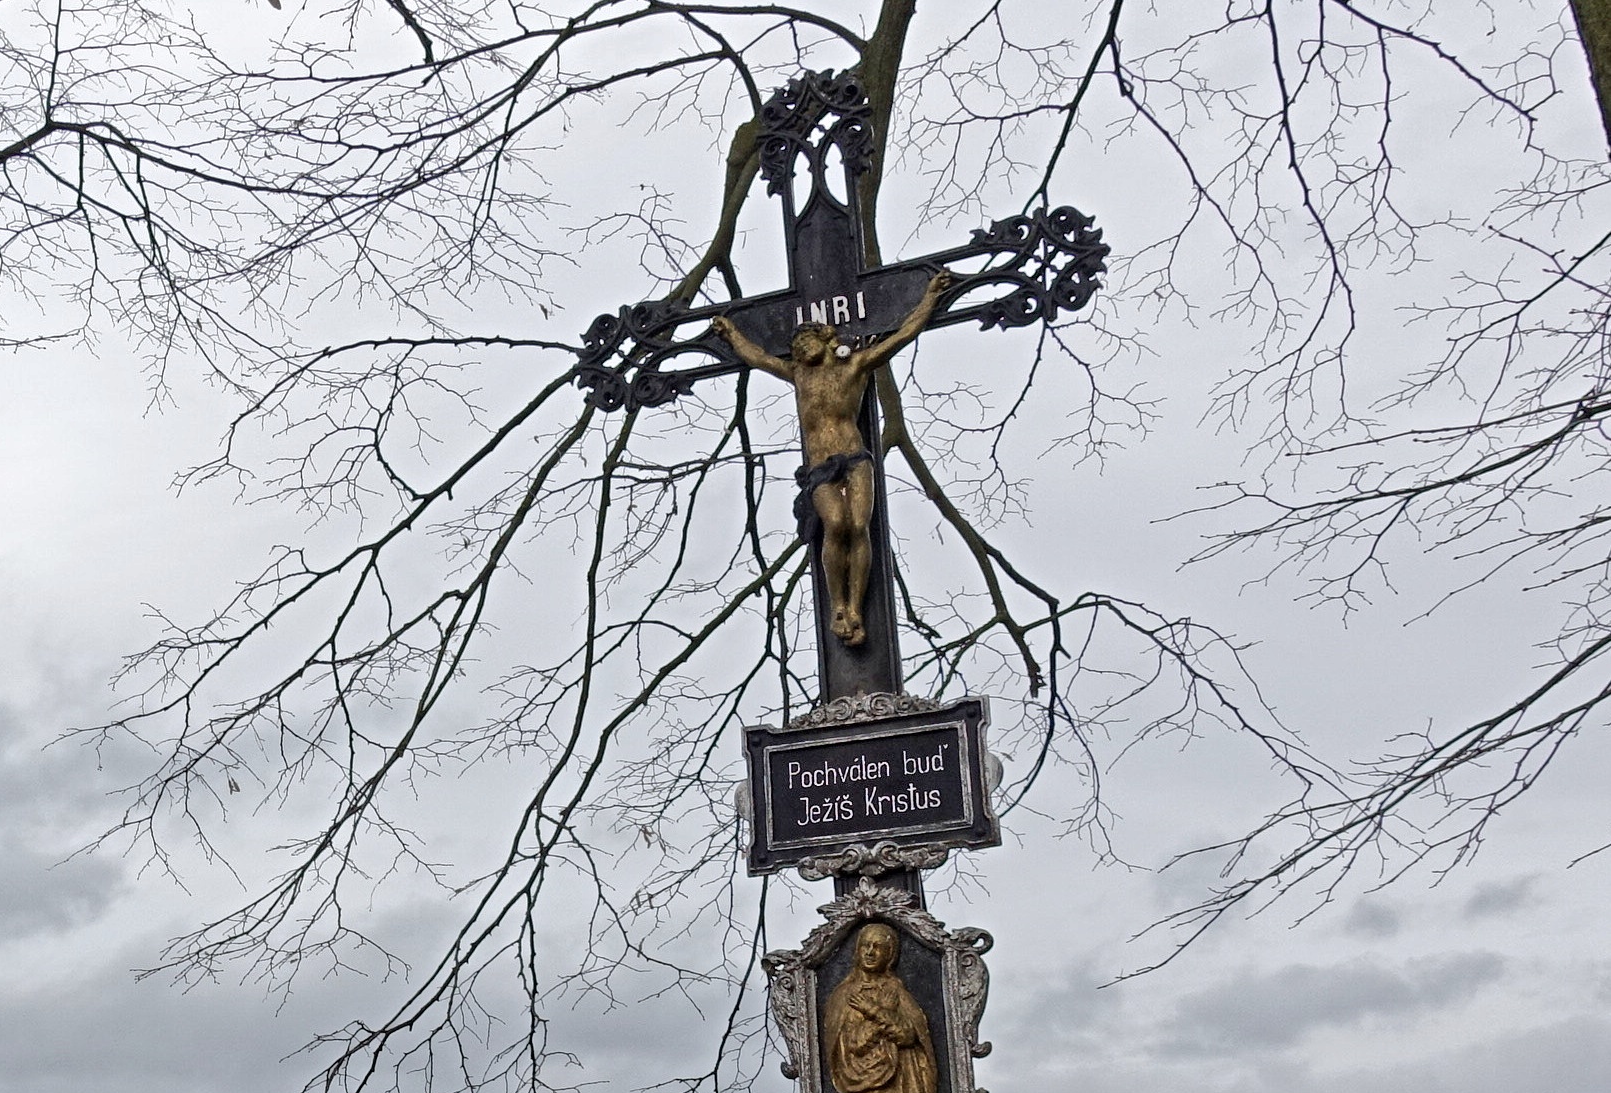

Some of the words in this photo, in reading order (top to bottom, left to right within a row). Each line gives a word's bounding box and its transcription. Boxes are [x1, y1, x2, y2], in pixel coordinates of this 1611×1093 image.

[796, 291, 866, 326] INRI
[788, 755, 890, 789] Pochválen
[902, 743, 949, 775] buď
[797, 793, 854, 826] Ježíš
[865, 783, 941, 816] Kristus
